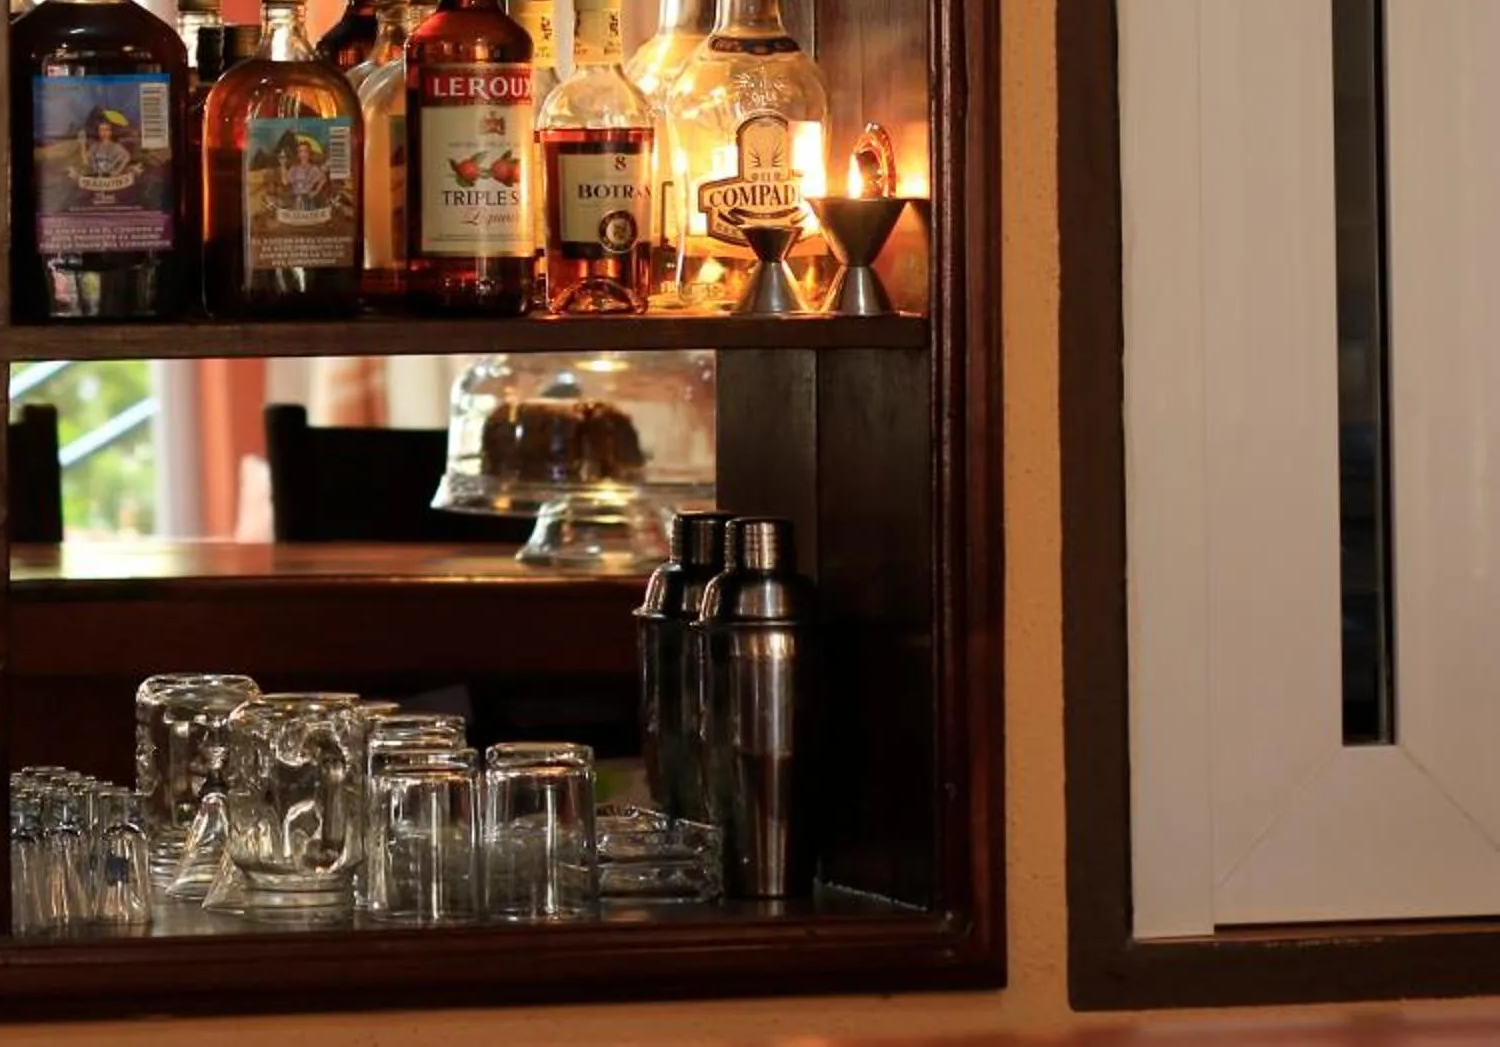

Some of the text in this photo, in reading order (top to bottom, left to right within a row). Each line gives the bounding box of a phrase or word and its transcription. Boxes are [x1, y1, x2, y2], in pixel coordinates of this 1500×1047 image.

[433, 76, 532, 100] LEROUX
[614, 156, 627, 170] 8
[442, 190, 507, 207] TRIPLE
[708, 184, 798, 208] COMPAD
